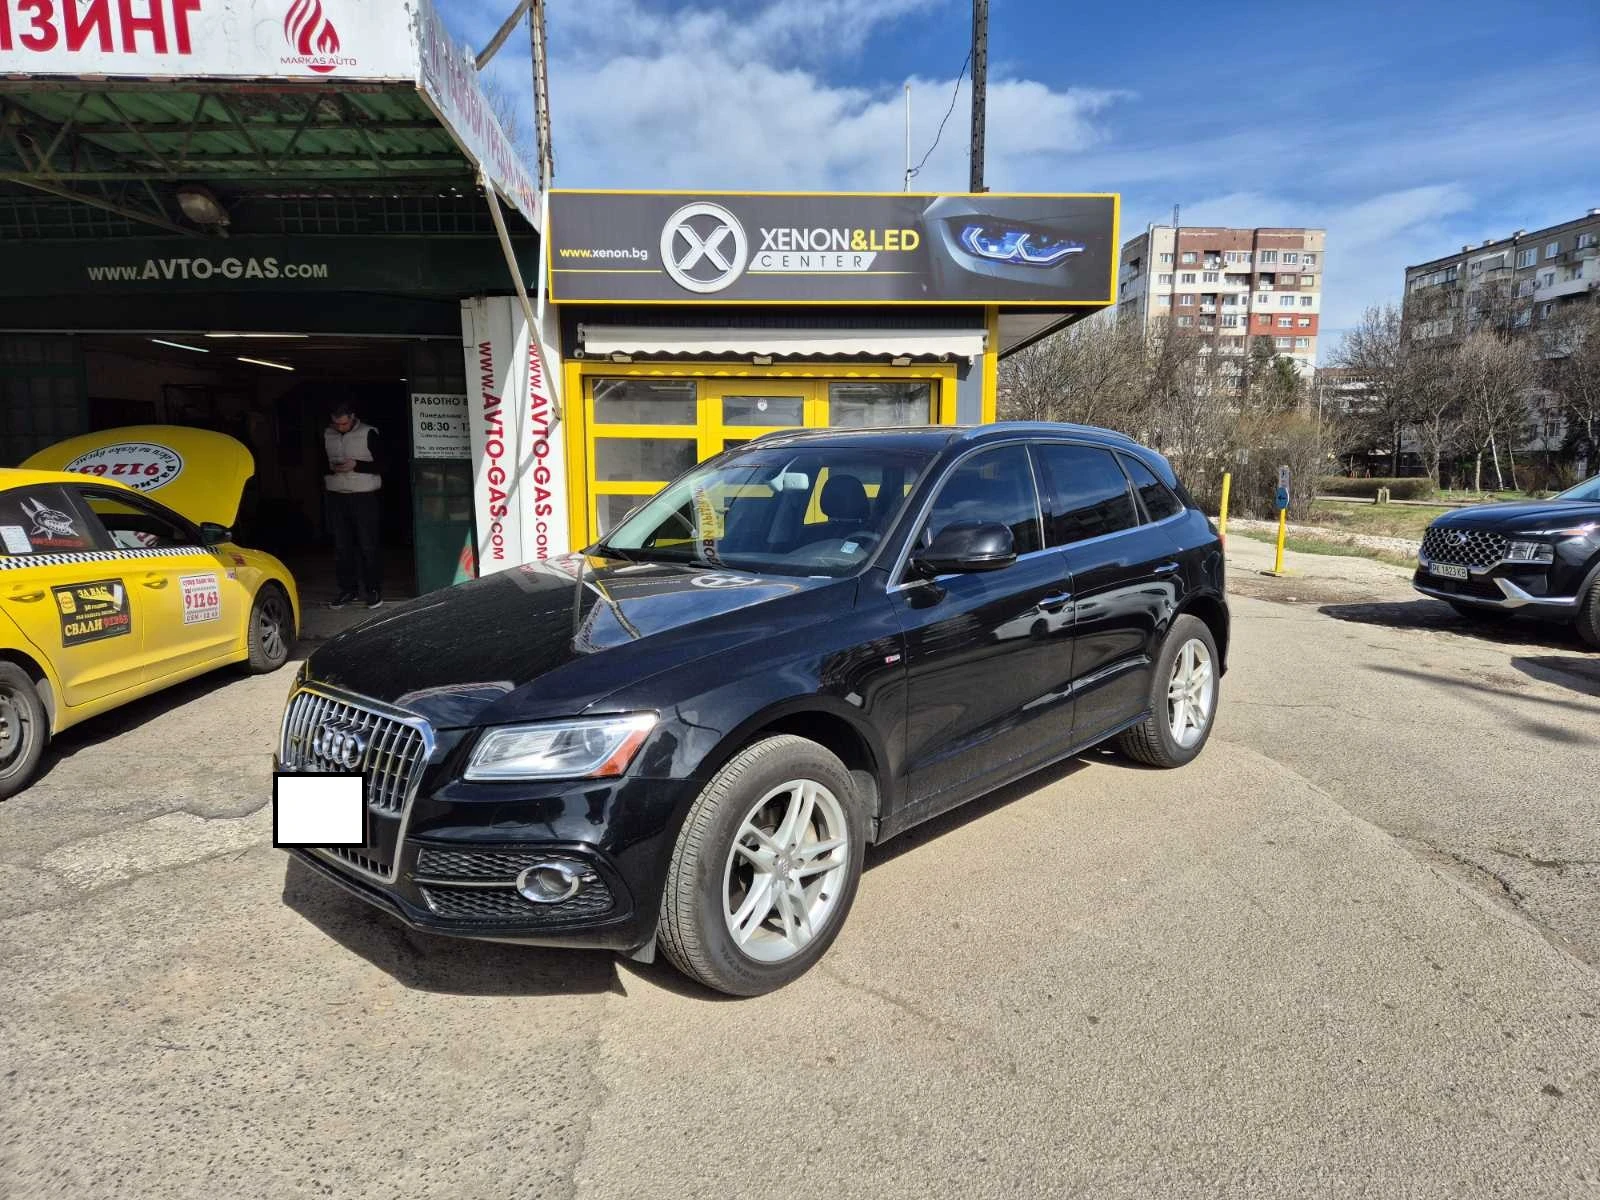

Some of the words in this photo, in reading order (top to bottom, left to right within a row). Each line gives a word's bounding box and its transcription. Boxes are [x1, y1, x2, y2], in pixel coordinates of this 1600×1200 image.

[0, 0, 201, 55] ЗИНГ
[280, 57, 326, 65] MARKAS
[328, 58, 357, 66] AUTO
[759, 227, 920, 251] XENON&LED
[560, 249, 648, 260] www.xenon.bg
[761, 255, 863, 268] CENTER
[414, 397, 460, 406] РАБОТНО
[420, 421, 450, 431] 08:30
